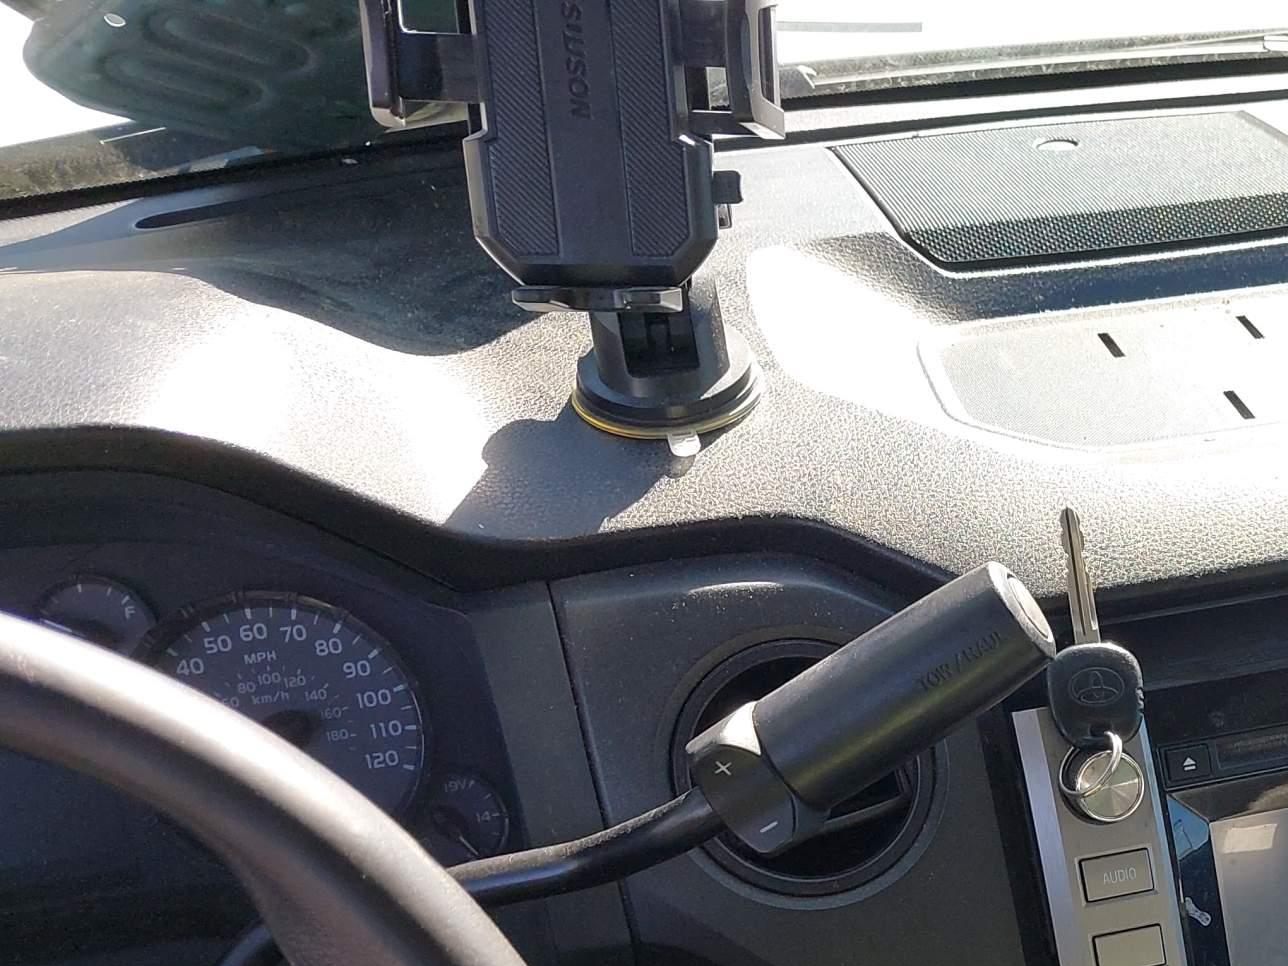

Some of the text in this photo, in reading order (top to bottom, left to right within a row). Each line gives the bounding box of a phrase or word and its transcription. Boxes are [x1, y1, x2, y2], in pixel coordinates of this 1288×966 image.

[125, 606, 135, 620] F
[239, 623, 267, 641] 60
[280, 625, 306, 643] 70
[204, 635, 232, 654] 50
[315, 638, 342, 656] 80
[244, 651, 276, 665] MPH
[176, 658, 204, 676] 40
[343, 660, 371, 678] 90
[257, 672, 281, 685] 100
[284, 675, 306, 689] 120
[238, 682, 256, 694] 80
[305, 689, 327, 702] 140
[252, 691, 290, 705] km/h
[357, 689, 391, 708] 100
[321, 707, 342, 720] 160
[370, 720, 402, 739] 110
[365, 750, 399, 769] 120
[1103, 867, 1137, 884] AUDIO
